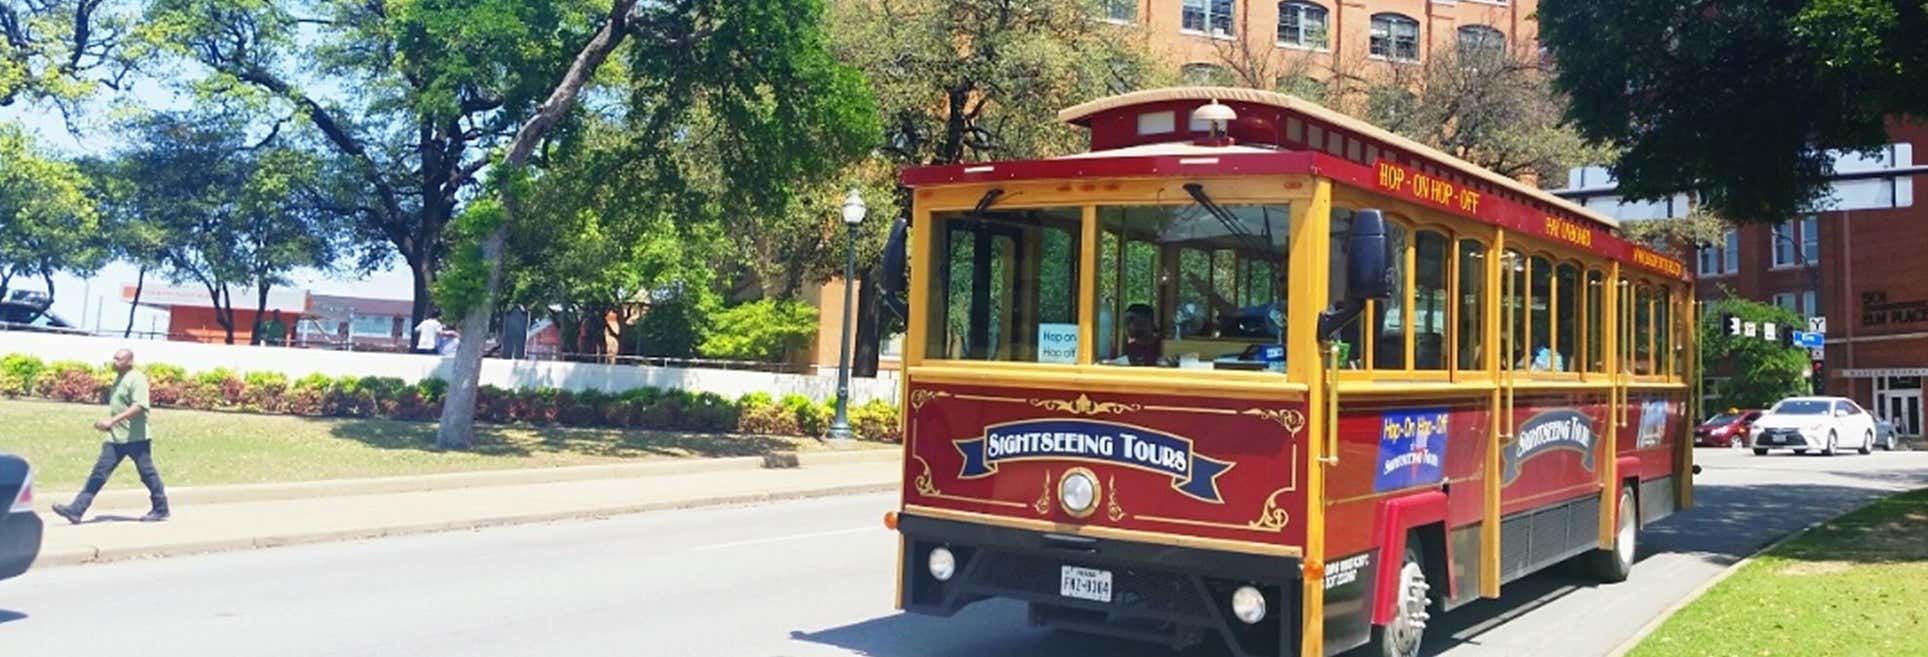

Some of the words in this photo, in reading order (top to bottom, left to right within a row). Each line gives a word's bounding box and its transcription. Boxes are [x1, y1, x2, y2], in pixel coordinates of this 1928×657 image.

[1380, 163, 1405, 190] HOP
[1413, 173, 1430, 198] ON
[1431, 179, 1453, 206] HOP
[1460, 188, 1480, 214] OFF
[1043, 331, 1061, 345] Hop
[1383, 416, 1415, 444] Hop-On
[987, 431, 1114, 457] SIGHTSEEING
[1119, 433, 1188, 471] TOURS
